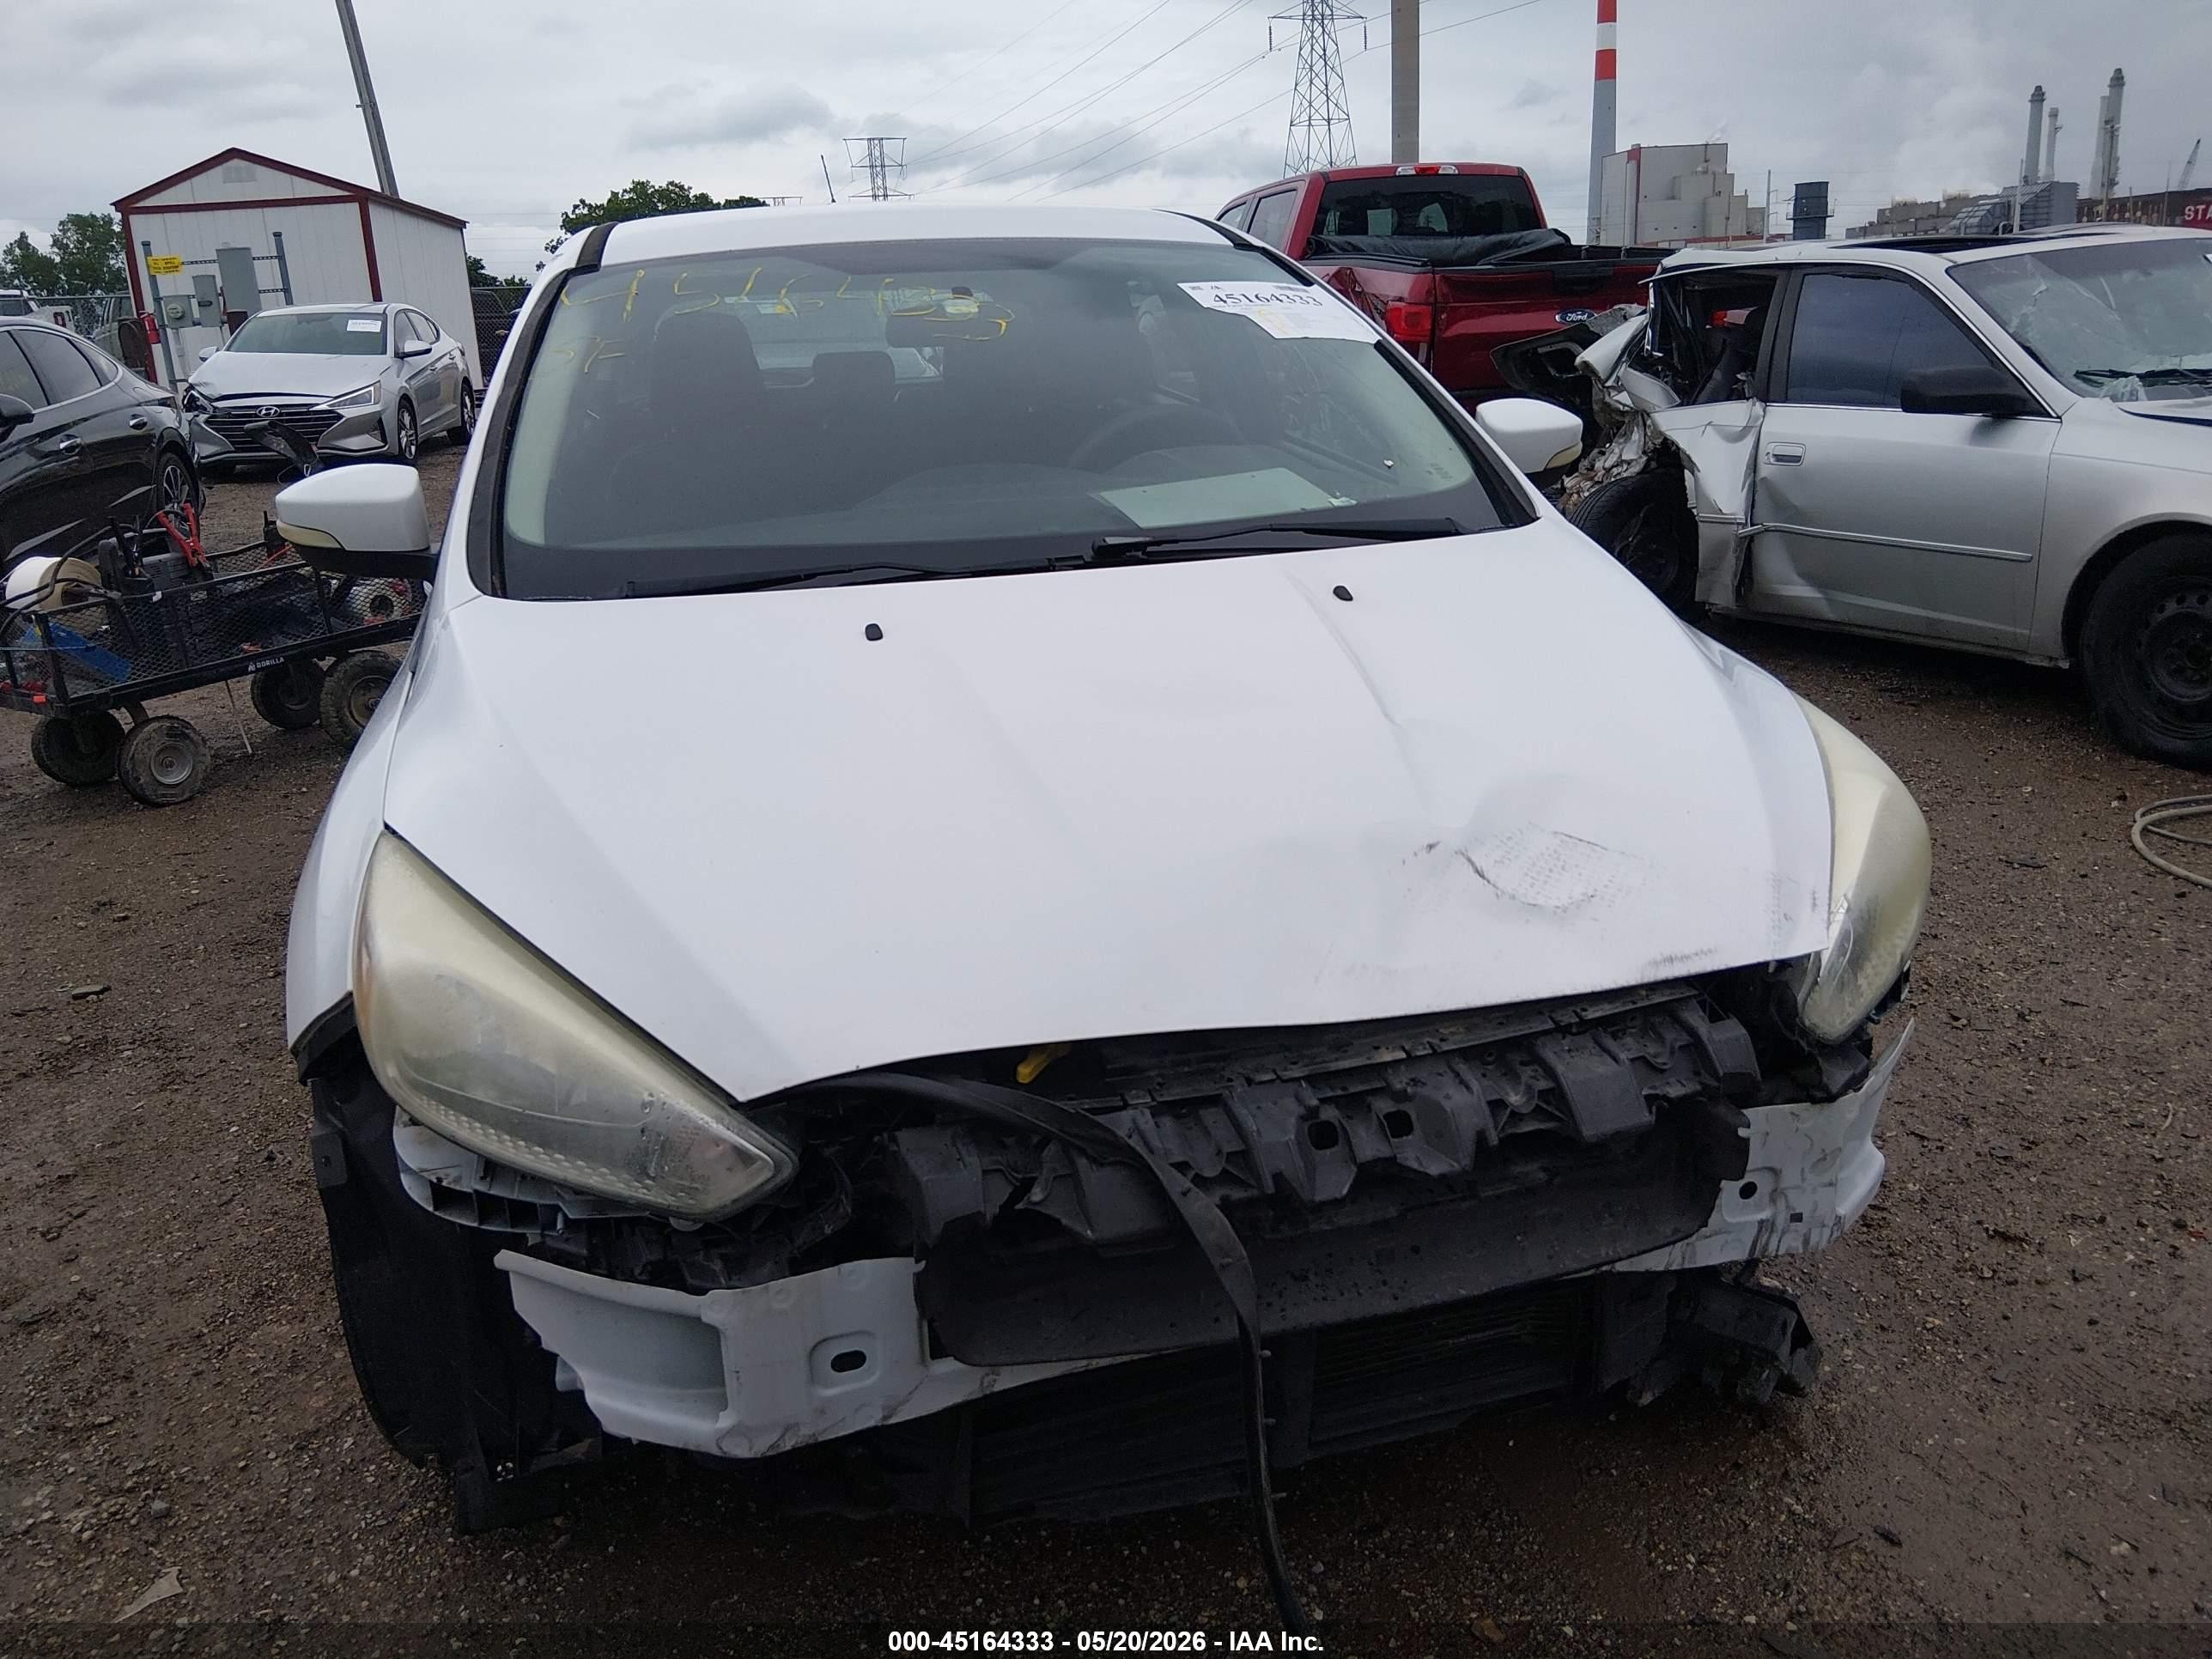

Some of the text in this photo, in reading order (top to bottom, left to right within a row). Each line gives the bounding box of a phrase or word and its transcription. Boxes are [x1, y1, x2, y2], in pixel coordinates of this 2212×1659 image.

[1212, 293, 1323, 307] 45164333
[1565, 311, 1589, 322] Ford
[256, 656, 285, 669] GORILLA
